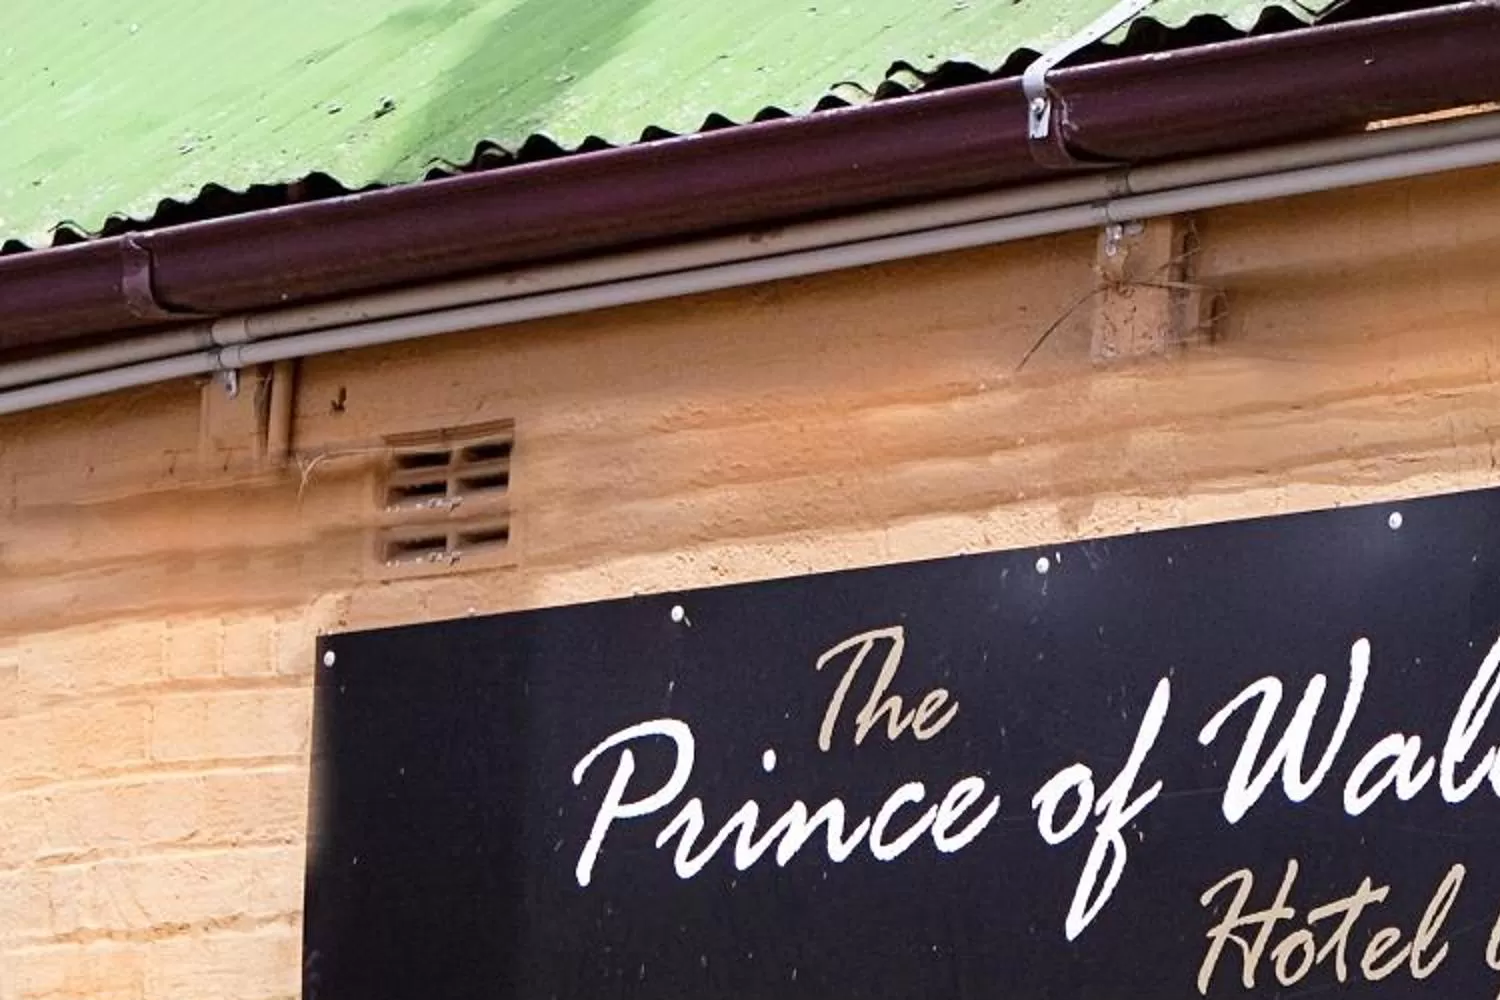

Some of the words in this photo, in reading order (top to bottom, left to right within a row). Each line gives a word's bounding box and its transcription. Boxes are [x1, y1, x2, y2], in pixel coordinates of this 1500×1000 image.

[816, 626, 960, 753] The
[571, 717, 1001, 887] Prince
[1031, 676, 1171, 942] of
[1197, 858, 1467, 995] Hotel
